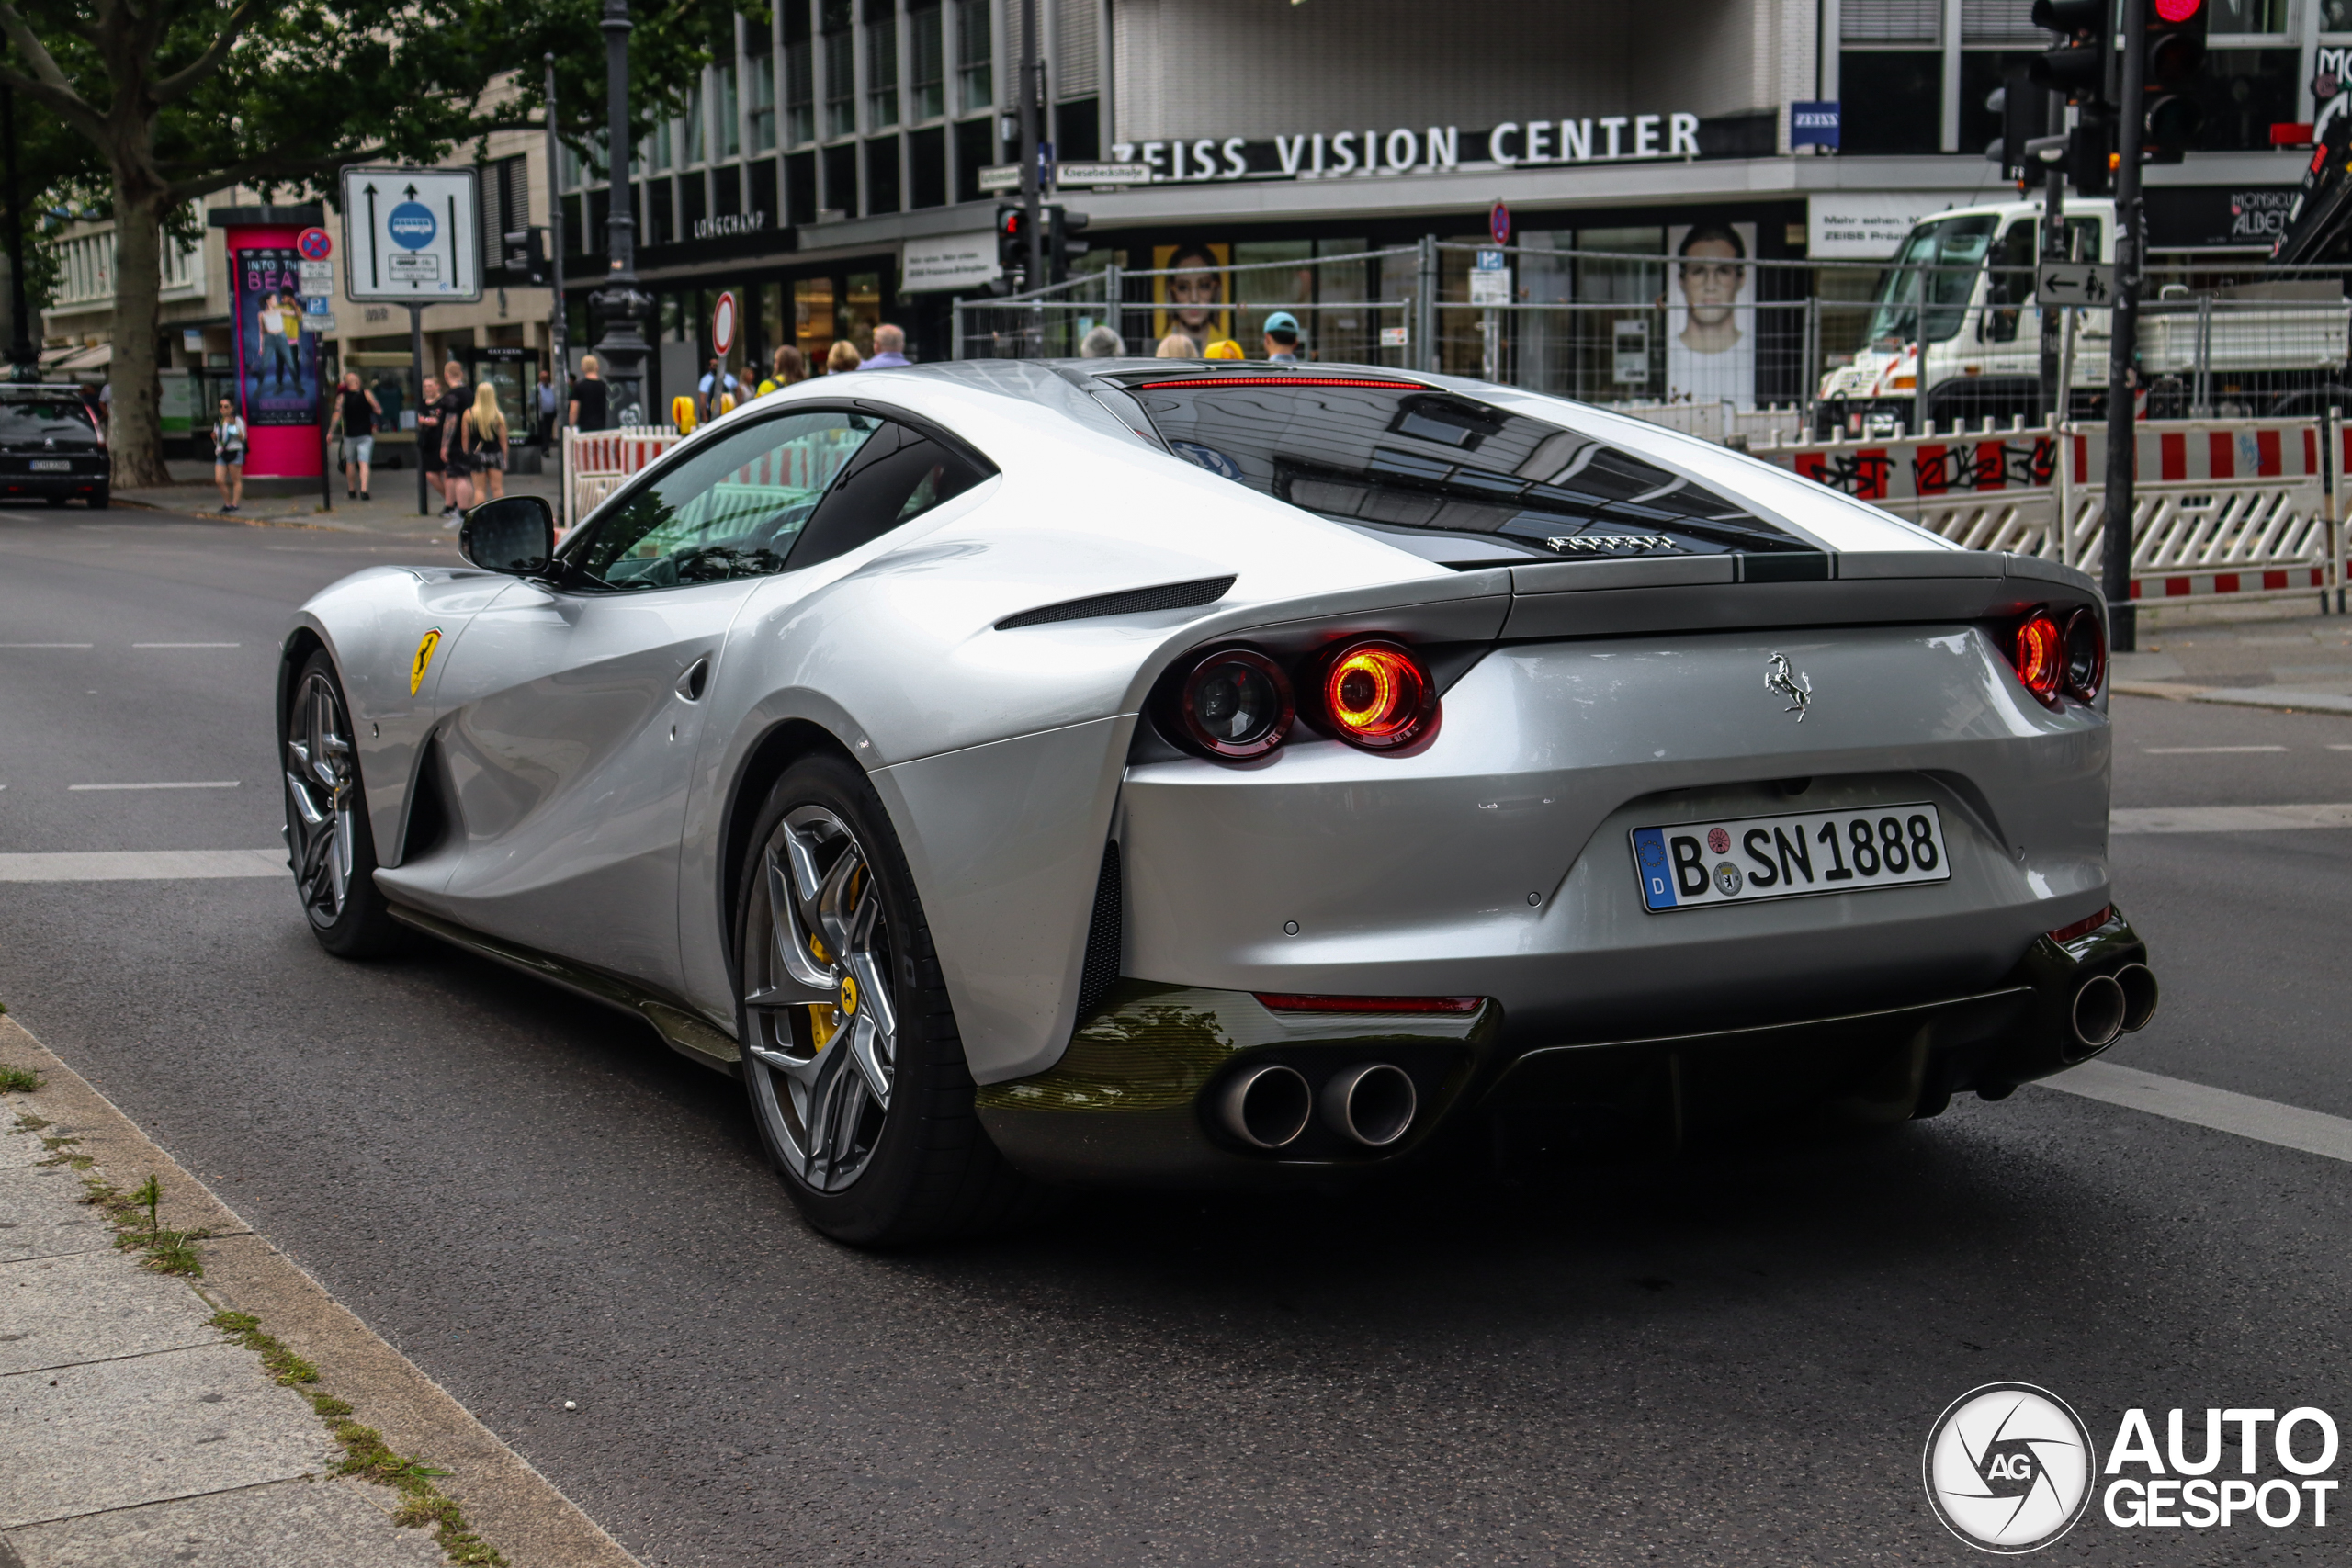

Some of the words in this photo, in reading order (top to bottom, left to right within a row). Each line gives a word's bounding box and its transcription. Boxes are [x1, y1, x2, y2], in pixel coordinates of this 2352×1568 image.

[1795, 112, 1838, 127] ZEISS
[1275, 126, 1459, 175] VISION
[1488, 112, 1701, 166] CENTER
[2231, 191, 2297, 209] MONSIEU
[694, 211, 765, 239] LONGCHAMP
[1824, 215, 1857, 225] Mehr
[1909, 215, 1921, 225] M
[1824, 231, 1866, 241] ZEISS
[247, 260, 278, 271] INTO
[283, 260, 300, 271] TH
[1547, 535, 1677, 551] FERRARI
[1670, 836, 1710, 896] B
[1652, 877, 1665, 895] D
